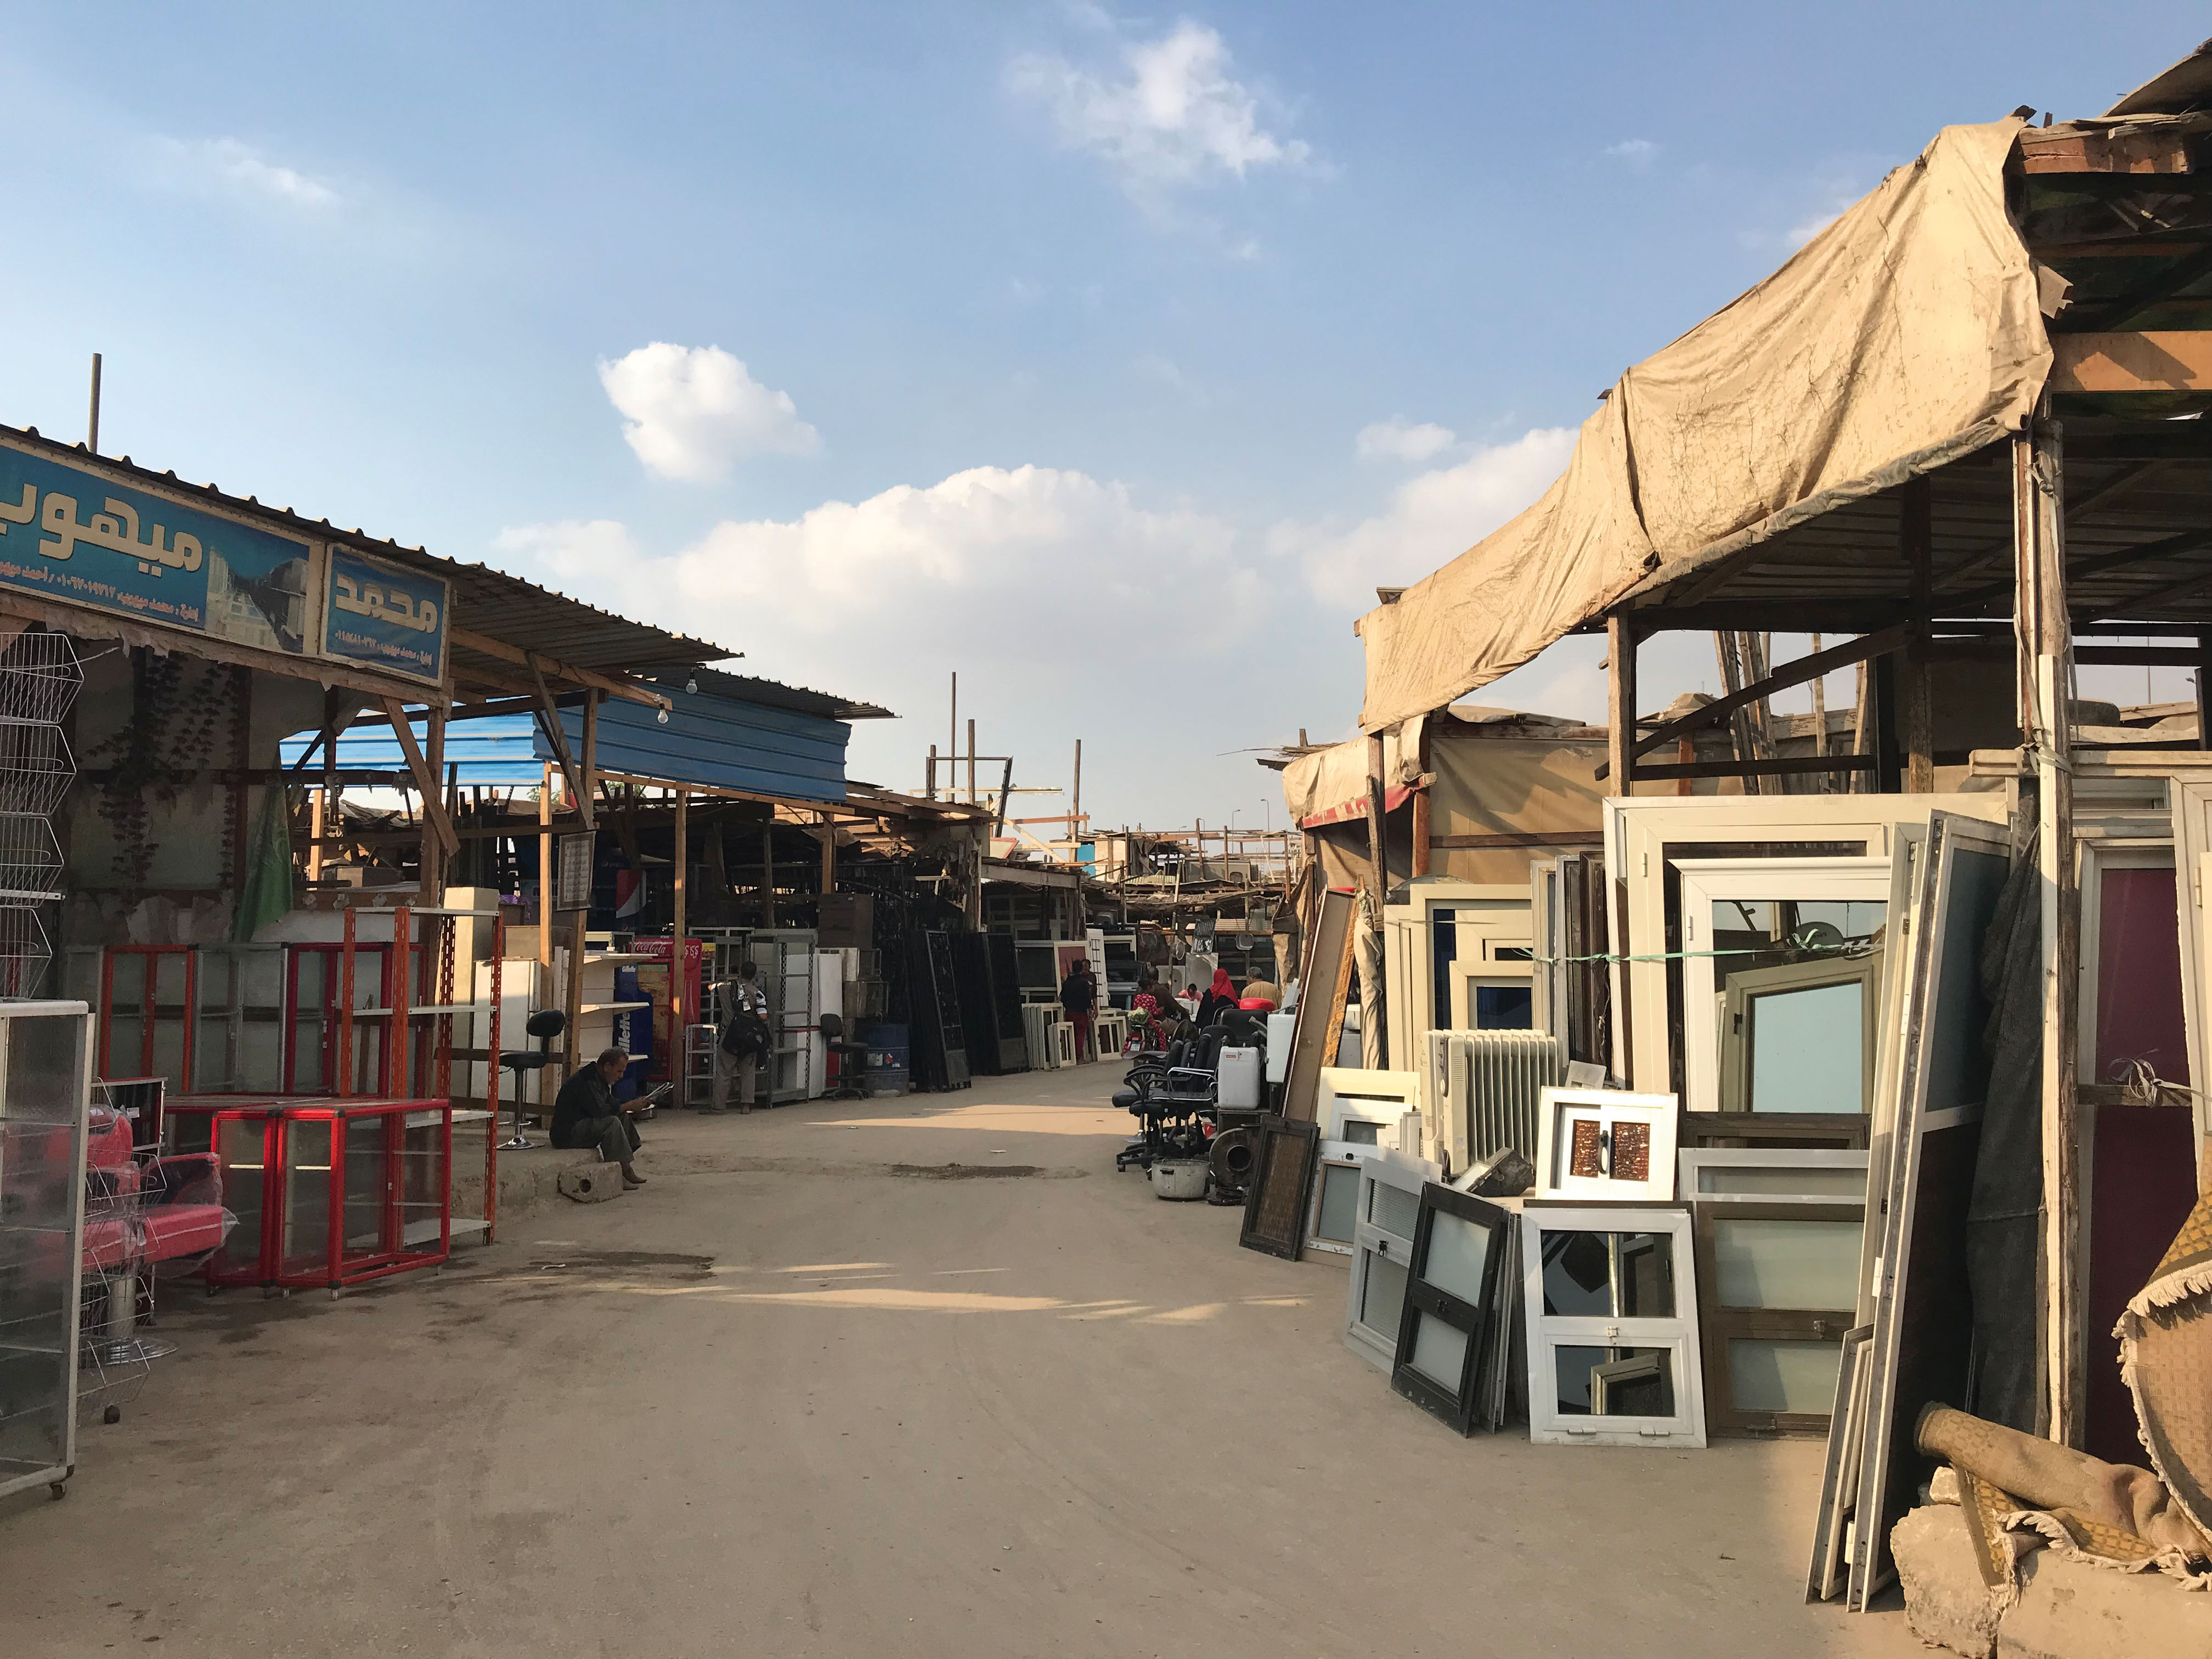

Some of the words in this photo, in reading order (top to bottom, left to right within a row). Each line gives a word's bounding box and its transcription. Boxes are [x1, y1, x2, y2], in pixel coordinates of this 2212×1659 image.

[149, 598, 174, 613] محمد
[336, 574, 437, 634] محمد
[618, 1011, 630, 1056] illette
